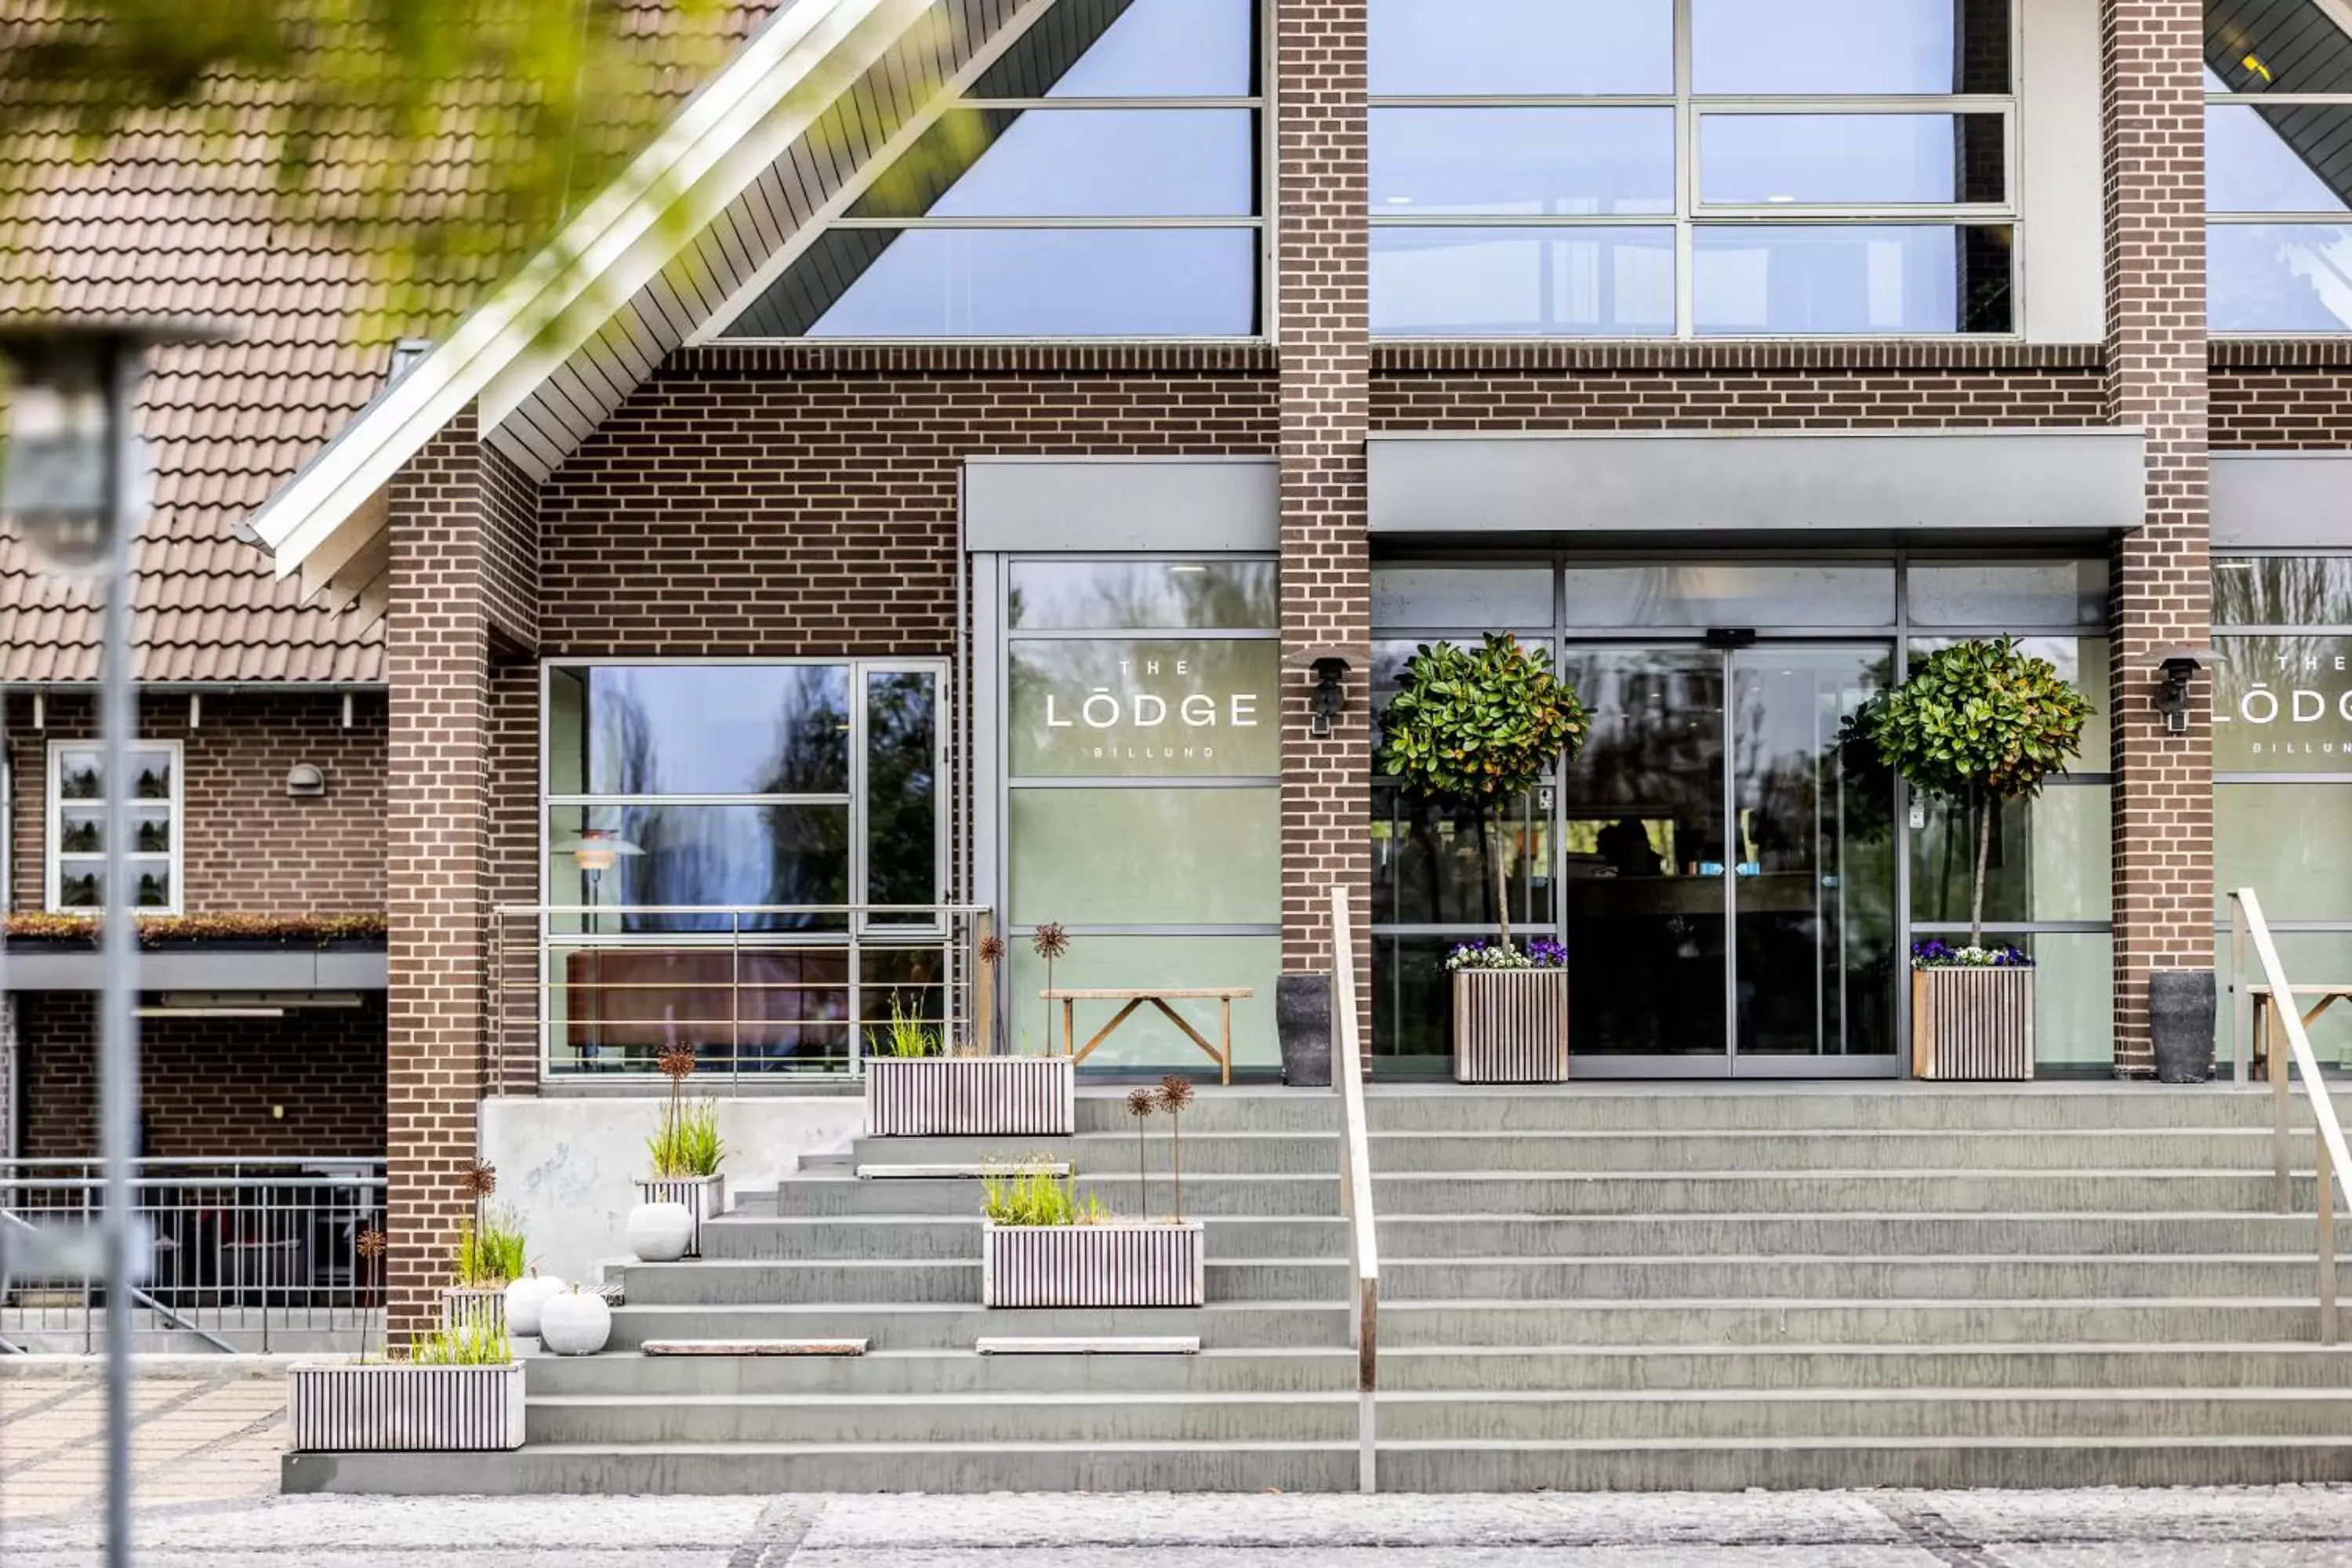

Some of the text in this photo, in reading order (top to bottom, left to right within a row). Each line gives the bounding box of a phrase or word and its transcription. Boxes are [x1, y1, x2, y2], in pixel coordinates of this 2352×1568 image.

[1120, 661, 1189, 675] THE
[2278, 656, 2346, 670] THE
[1047, 688, 1257, 728] LŌDGE
[1094, 746, 1214, 759] BILLUND
